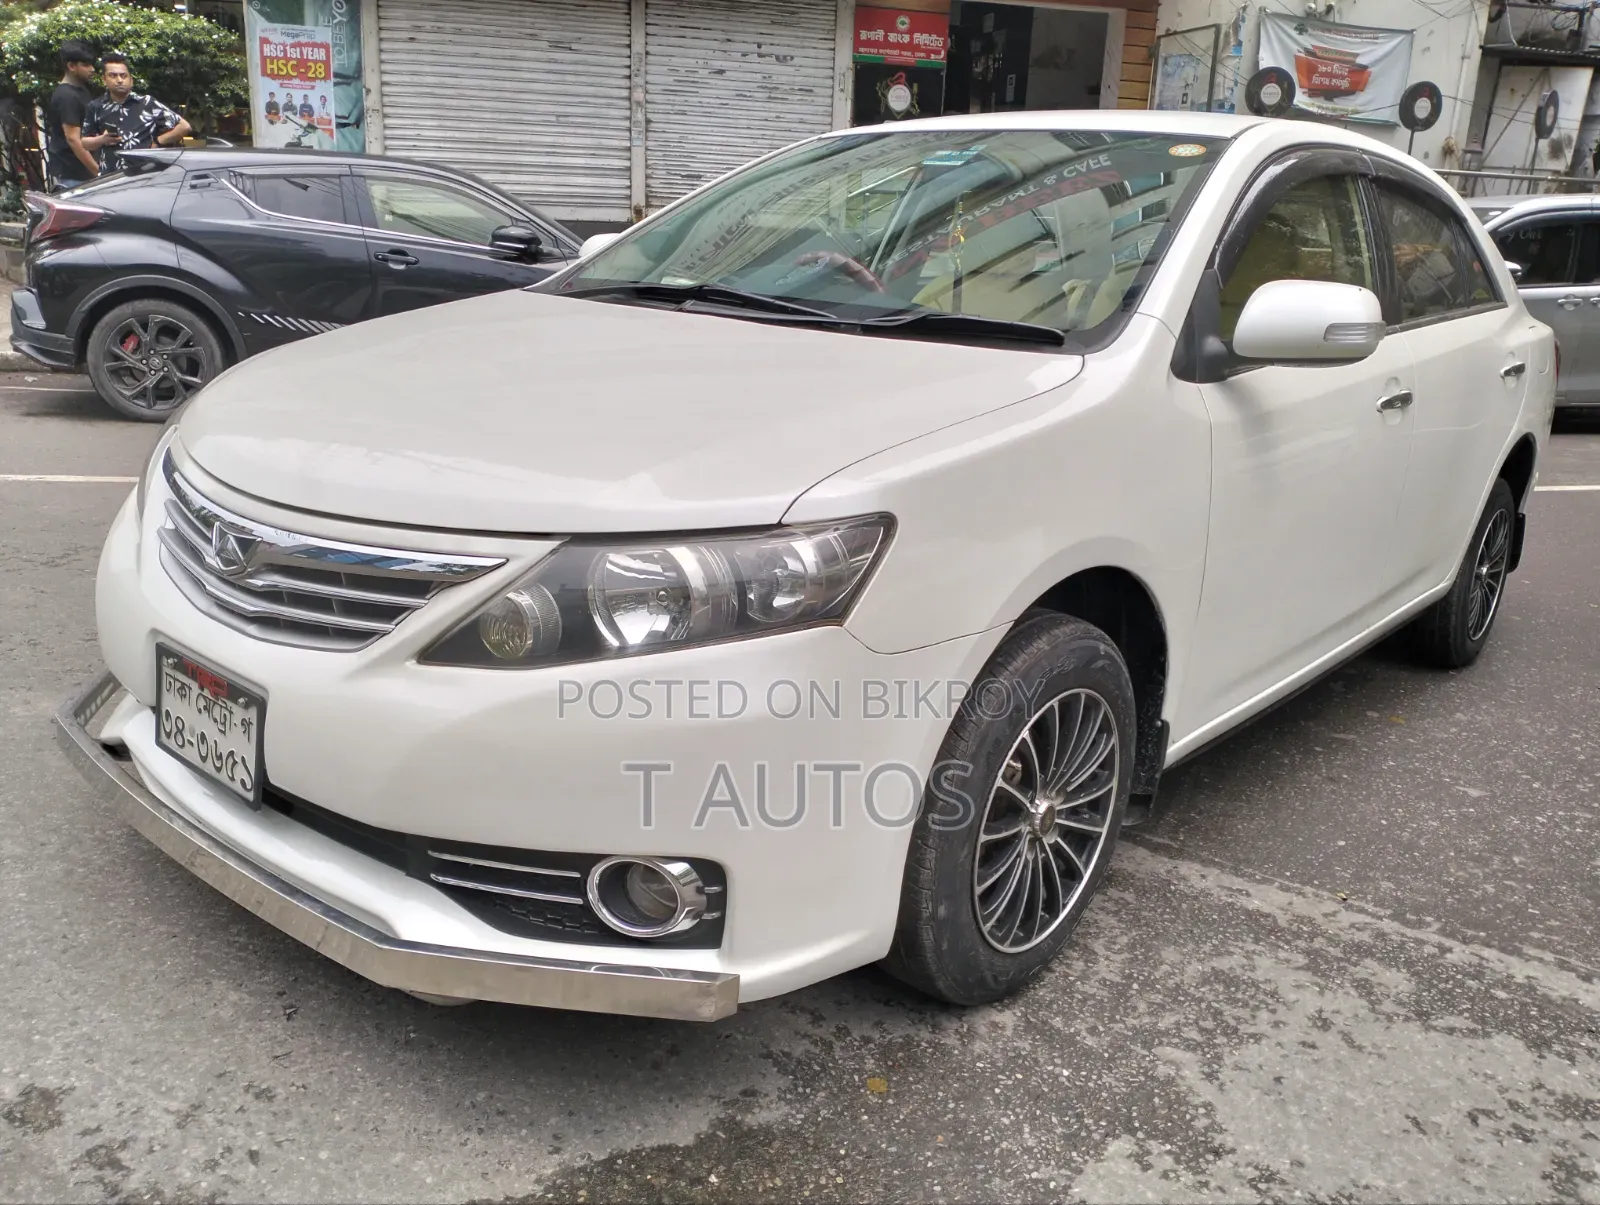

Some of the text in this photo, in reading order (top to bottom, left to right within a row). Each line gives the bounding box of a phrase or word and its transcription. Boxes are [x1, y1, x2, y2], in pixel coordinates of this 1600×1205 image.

[280, 31, 316, 40] MegaPrep
[859, 29, 944, 47] রূপালী ব্যাংক লিমিটেড
[263, 44, 326, 60] HSC 1st YEAR
[266, 58, 298, 77] HSC
[307, 61, 325, 78] 28
[182, 657, 228, 698] TRD
[165, 671, 192, 706] ঢাকা
[162, 708, 254, 792] ৩৪-৩৬৫১
